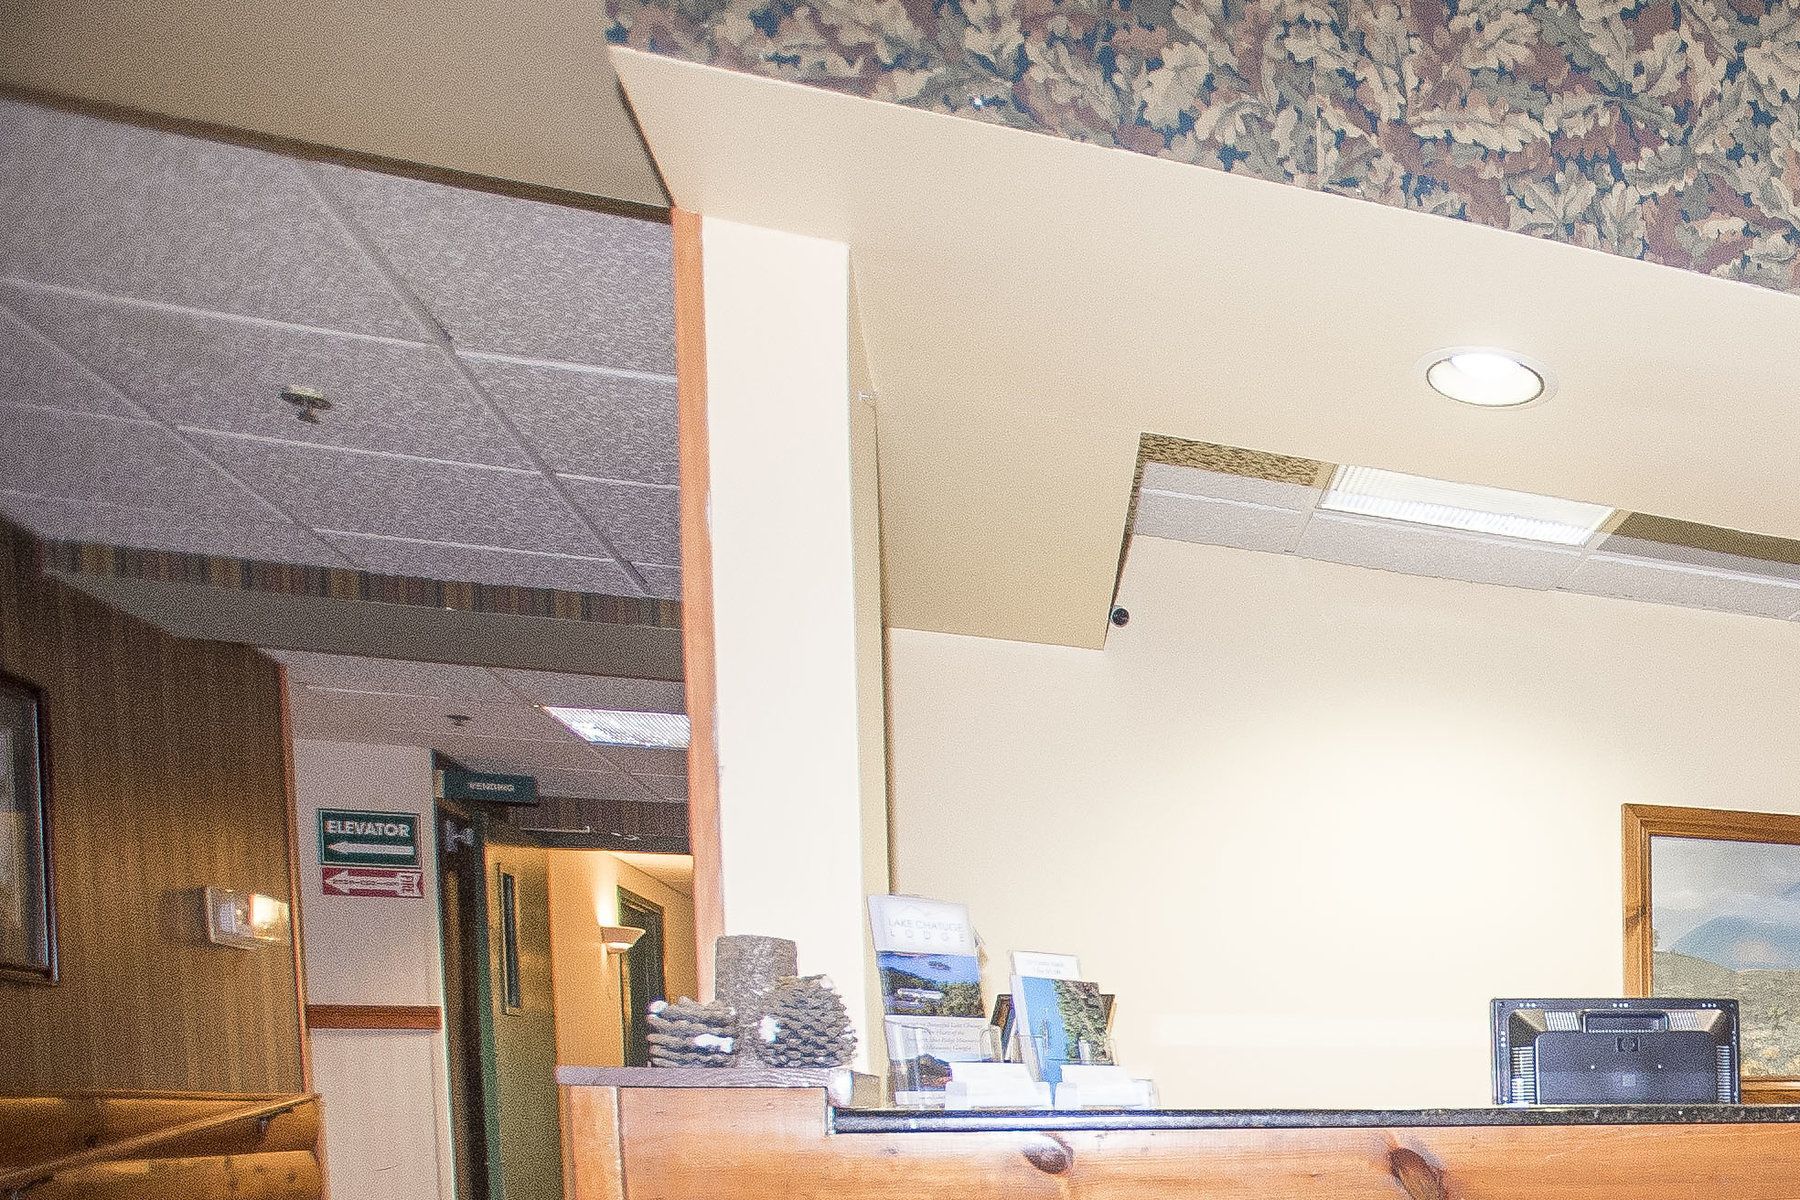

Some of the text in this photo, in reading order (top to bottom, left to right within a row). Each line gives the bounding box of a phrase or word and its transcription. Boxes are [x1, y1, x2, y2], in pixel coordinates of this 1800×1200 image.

[324, 819, 411, 838] ELEVATOR
[401, 874, 415, 894] FIRE
[888, 918, 913, 928] LAKE
